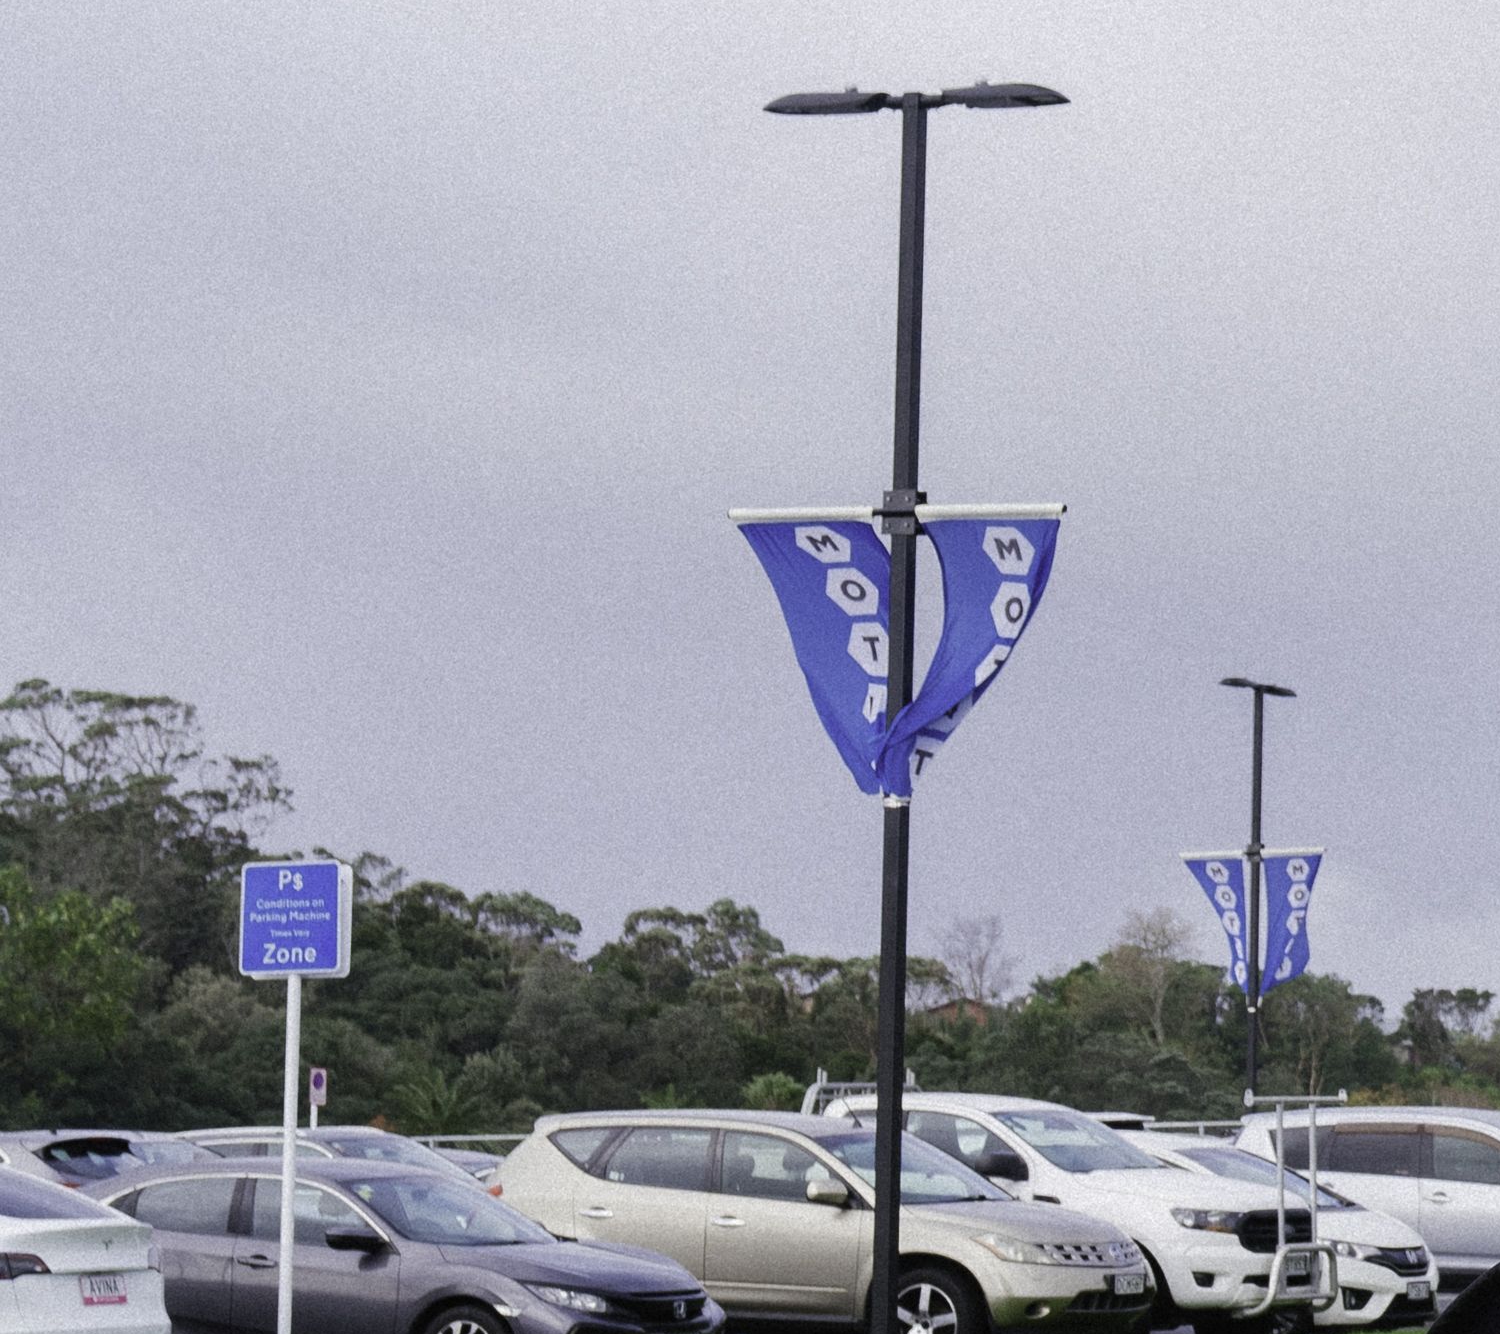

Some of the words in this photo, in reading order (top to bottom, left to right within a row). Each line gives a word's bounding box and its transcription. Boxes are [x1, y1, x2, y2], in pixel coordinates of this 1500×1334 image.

[256, 899, 310, 910] Conditions
[312, 899, 325, 908] on
[249, 912, 287, 924] Parking
[289, 910, 331, 921] Machine
[262, 943, 317, 965] Zone
[89, 1277, 120, 1297] AVINA
